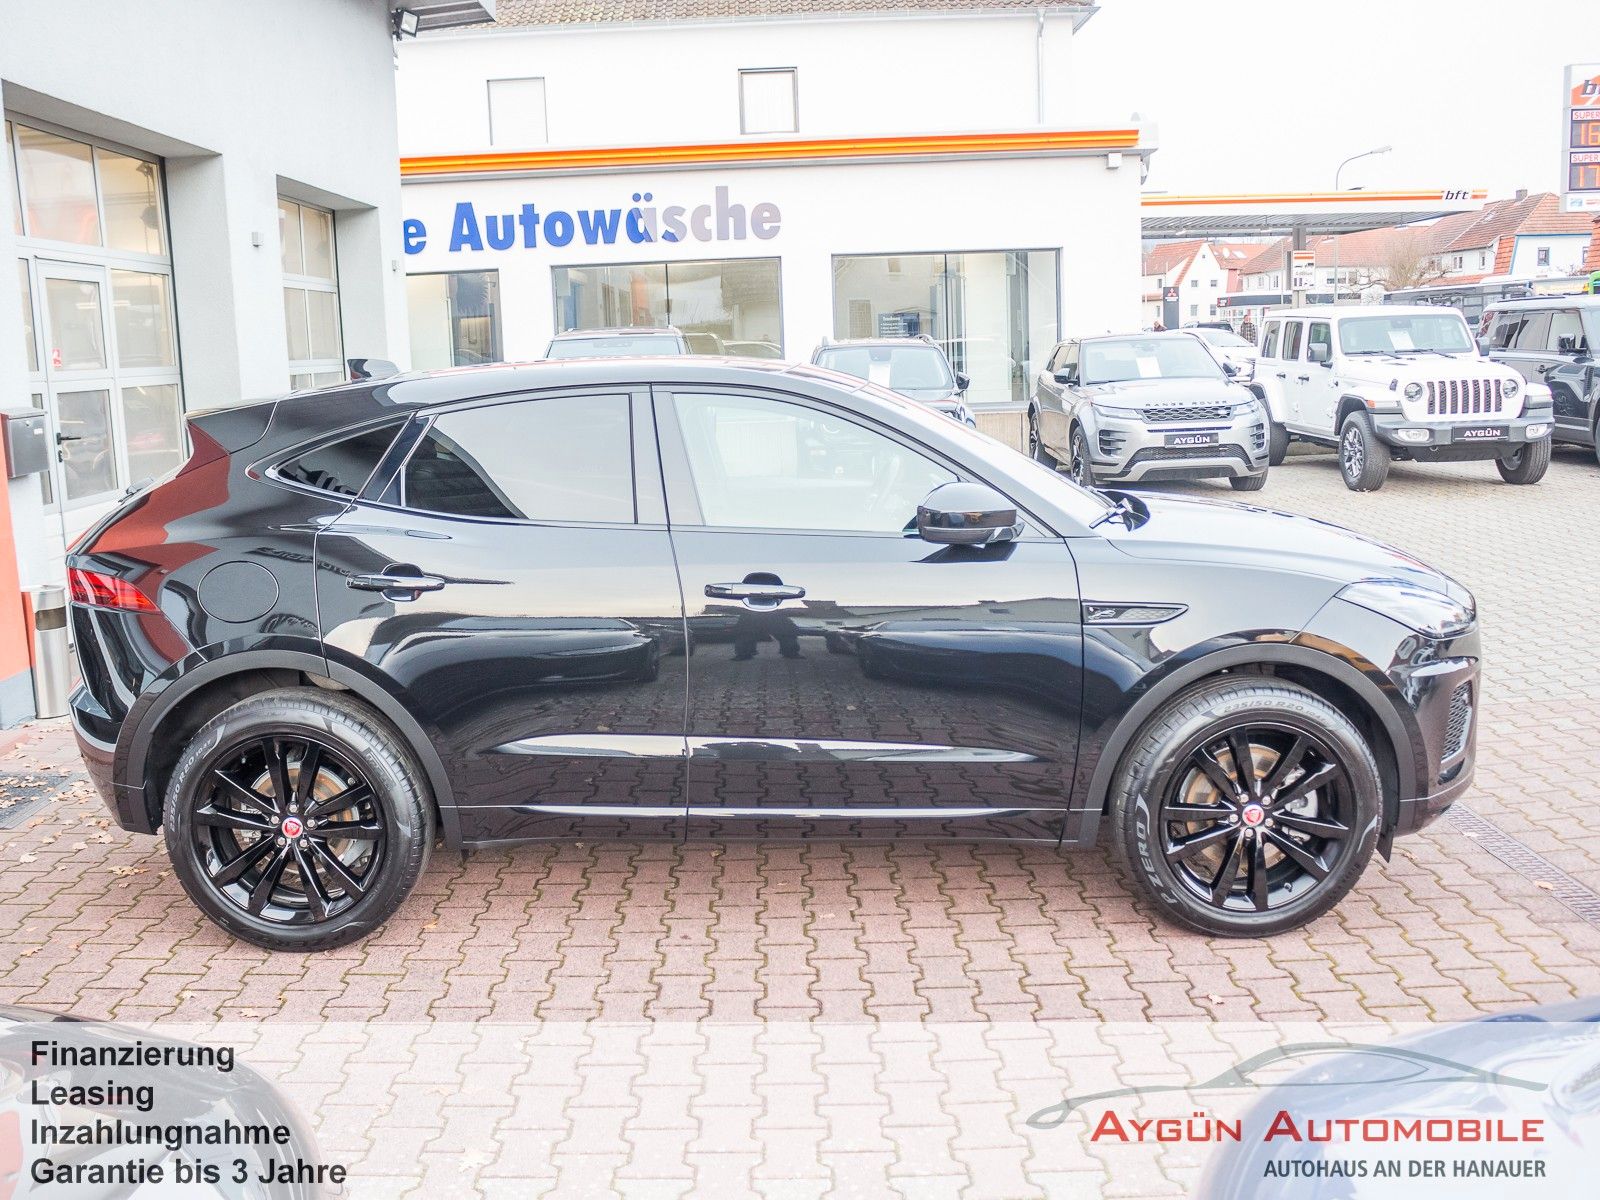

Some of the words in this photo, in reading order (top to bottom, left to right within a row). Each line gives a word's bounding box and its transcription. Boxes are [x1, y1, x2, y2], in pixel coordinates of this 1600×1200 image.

[1445, 189, 1470, 200] bft
[449, 185, 782, 253] Autowäsche
[1463, 427, 1501, 437] AYGÜN
[1173, 434, 1211, 445] AYGÜN
[1136, 820, 1164, 888] ZERO
[1160, 891, 1178, 904] P
